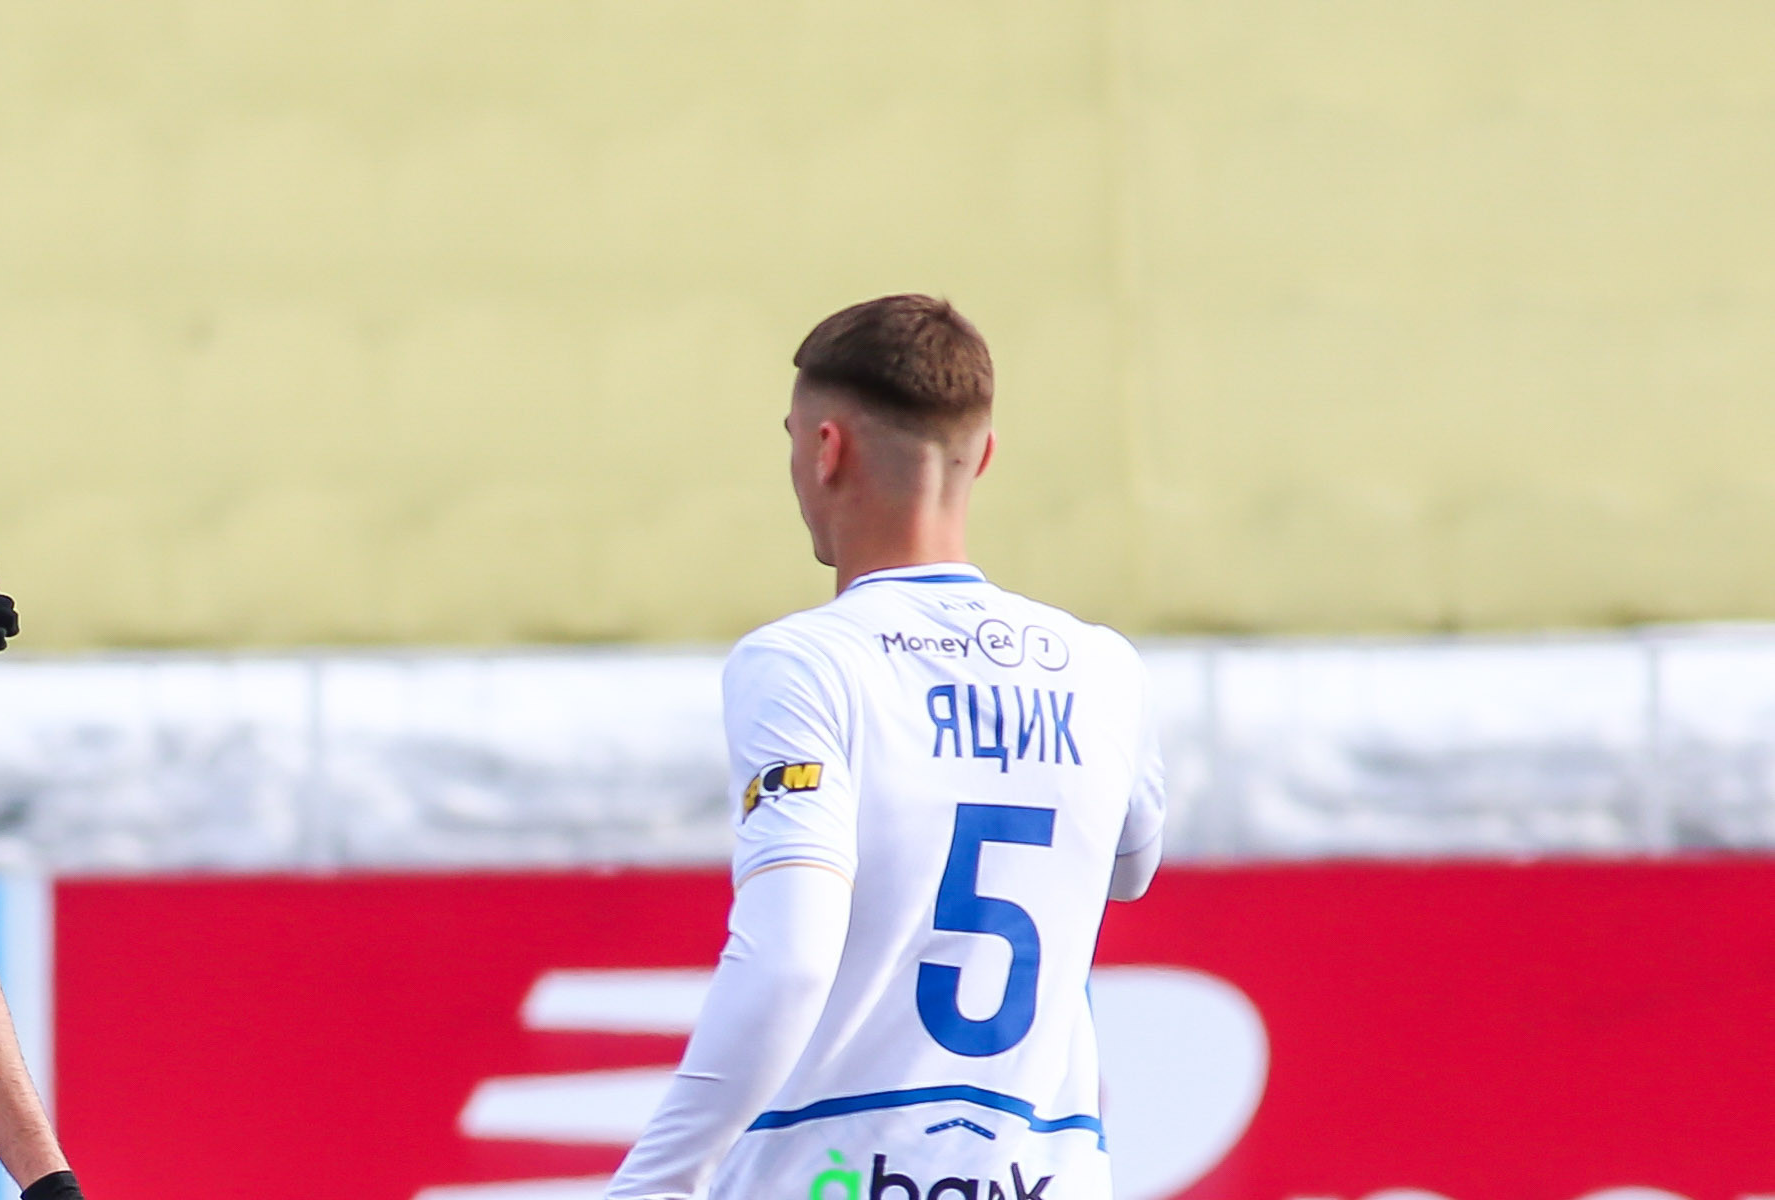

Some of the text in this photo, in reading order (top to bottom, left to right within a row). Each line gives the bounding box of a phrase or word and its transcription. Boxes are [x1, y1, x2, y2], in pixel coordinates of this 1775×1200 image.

[880, 632, 970, 658] Money
[927, 683, 1083, 774] ЯЦИК
[915, 802, 1056, 1058] 5
